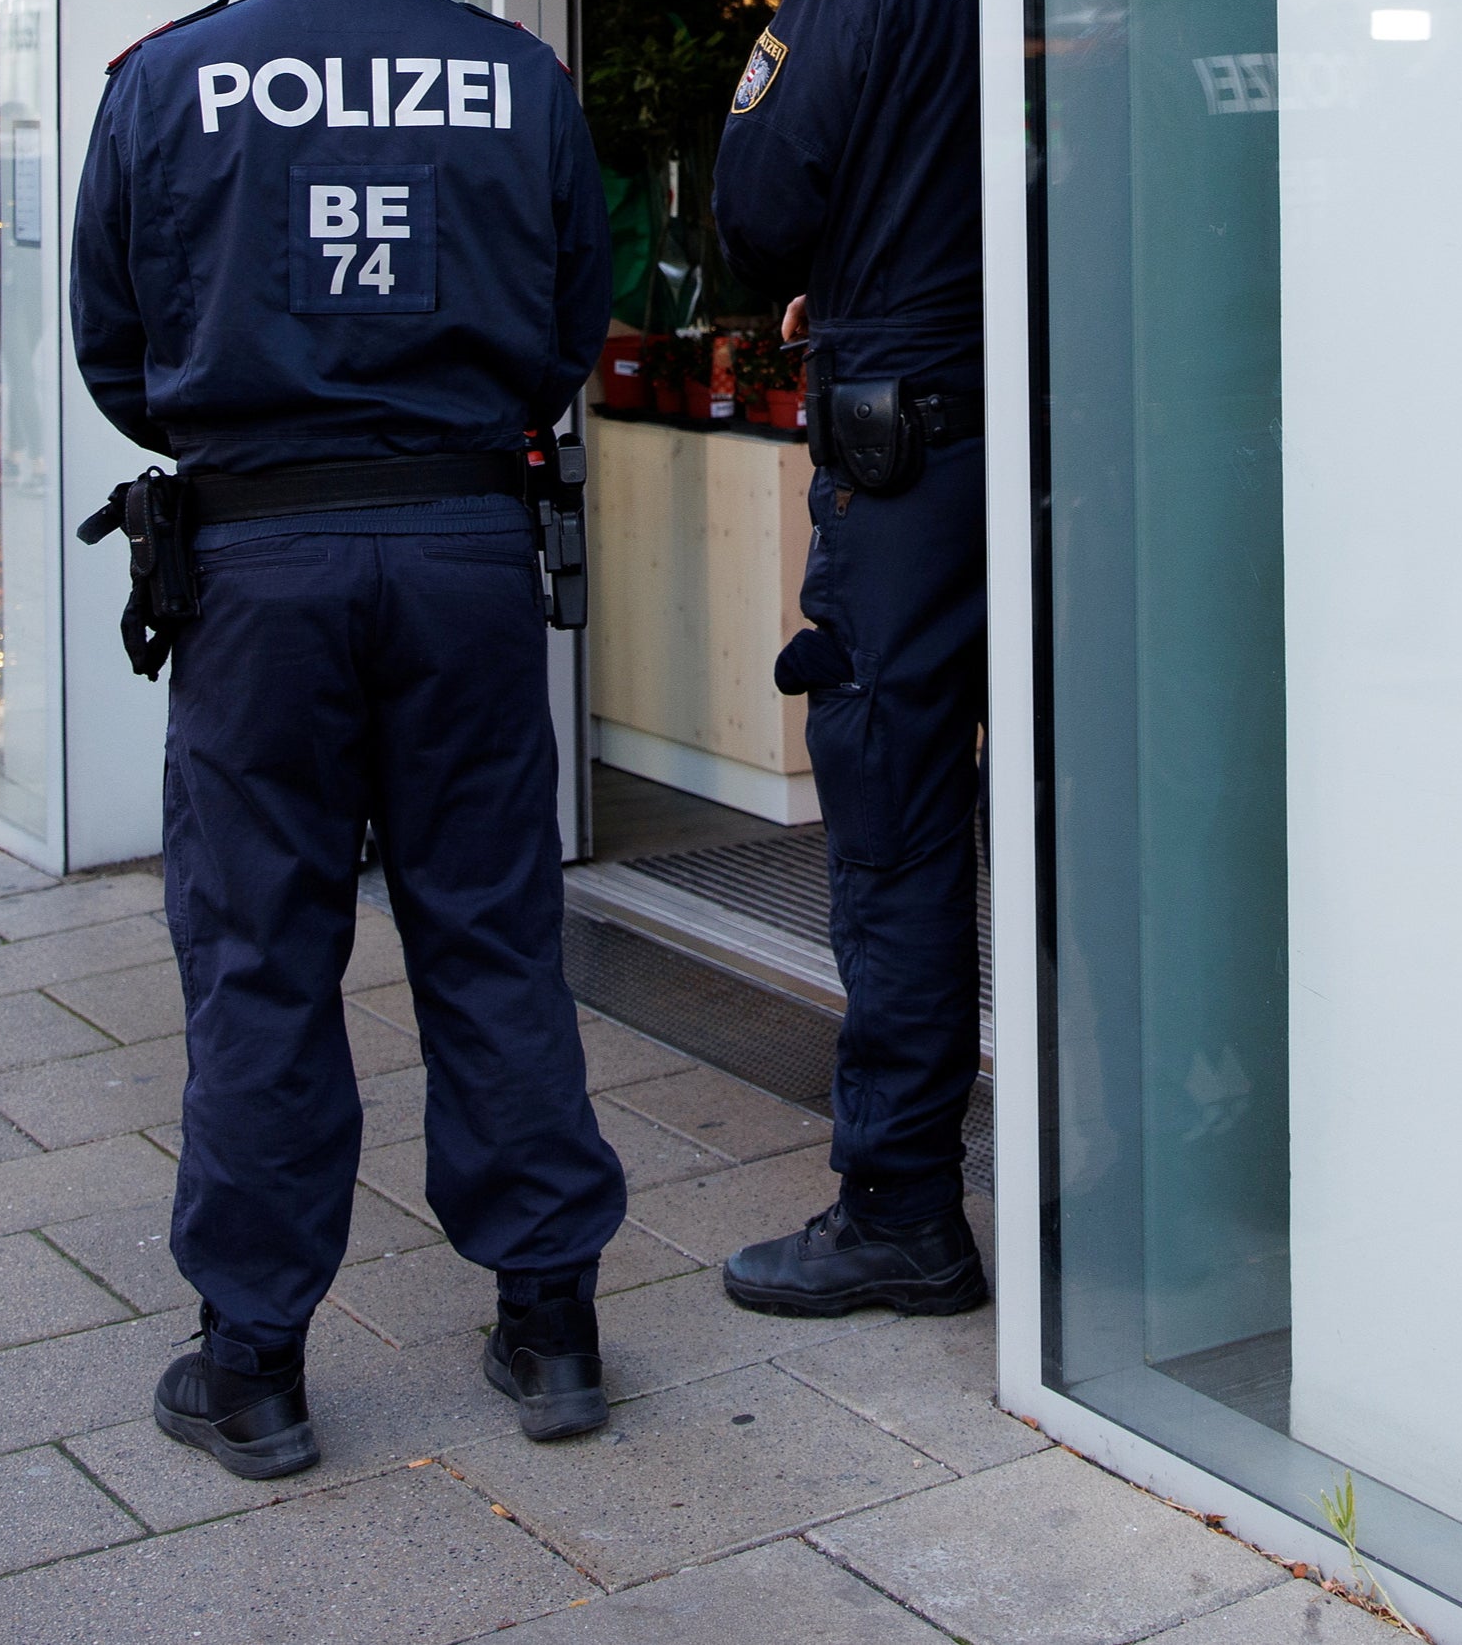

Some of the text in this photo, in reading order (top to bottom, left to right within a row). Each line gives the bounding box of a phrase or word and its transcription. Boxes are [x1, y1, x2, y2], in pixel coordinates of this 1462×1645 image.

[198, 57, 512, 133] POLIZEI
[309, 185, 411, 239] BE
[322, 243, 395, 295] 74
